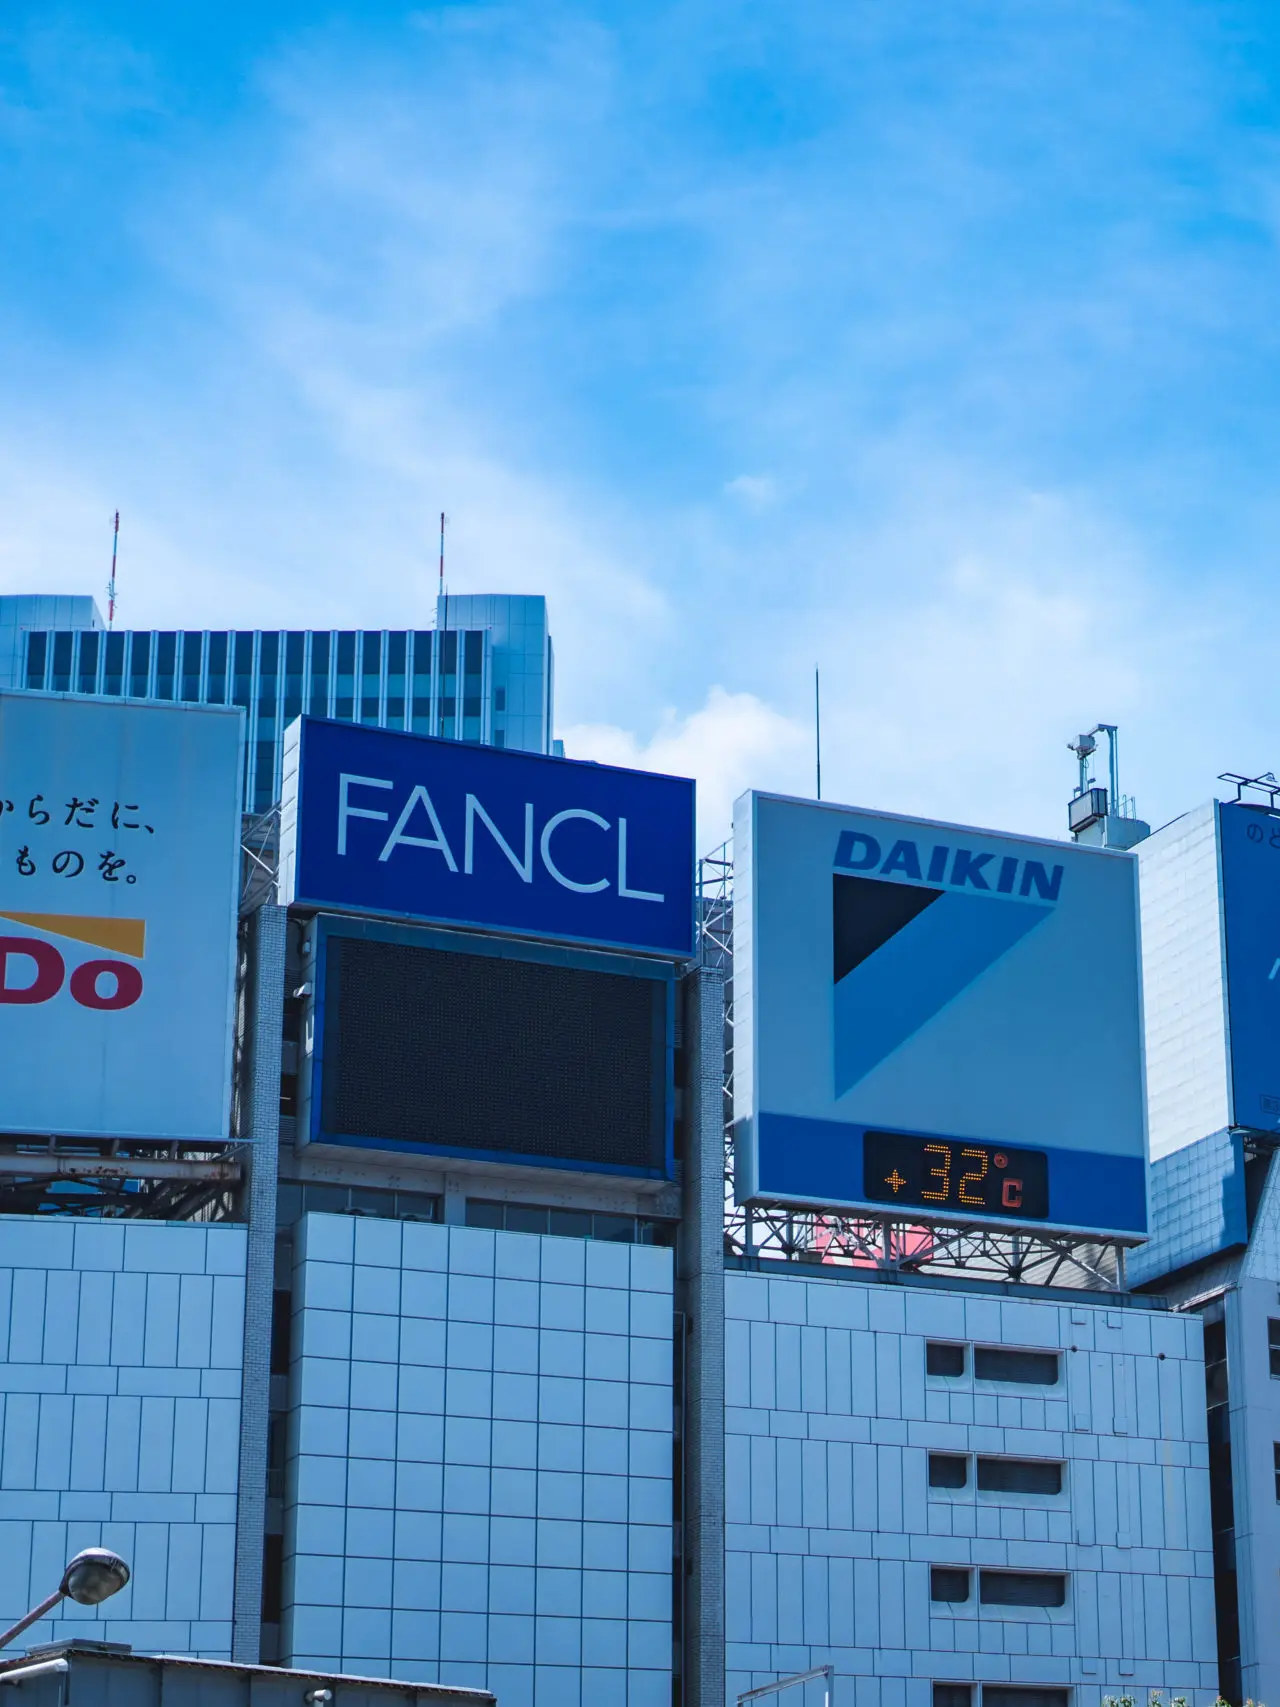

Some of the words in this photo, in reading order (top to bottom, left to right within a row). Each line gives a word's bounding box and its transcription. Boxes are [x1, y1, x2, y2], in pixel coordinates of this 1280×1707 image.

[16, 845, 137, 884] ものを。
[337, 773, 665, 903] FANCL
[833, 829, 1065, 902] DAIKIN
[0, 936, 143, 1011] Do
